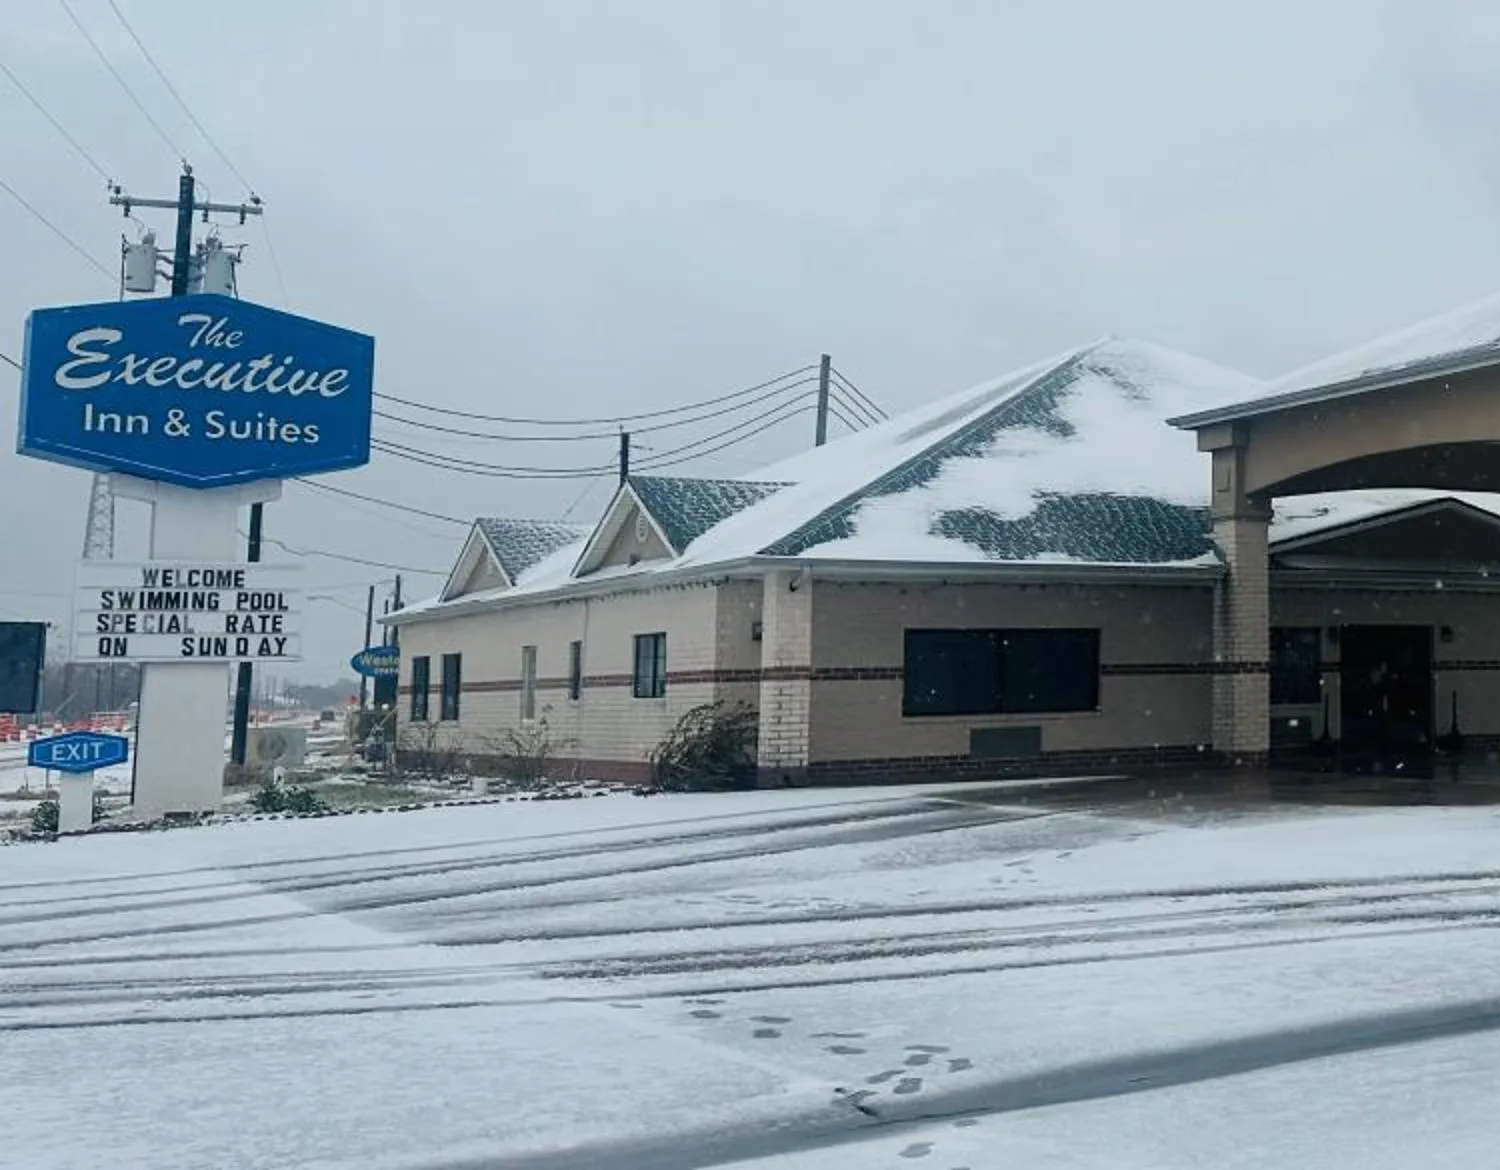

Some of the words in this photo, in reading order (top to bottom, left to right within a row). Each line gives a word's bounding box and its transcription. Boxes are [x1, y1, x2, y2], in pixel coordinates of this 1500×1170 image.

[178, 313, 243, 349] The
[55, 327, 349, 397] Executive
[84, 403, 149, 434] Inn
[163, 409, 190, 437] &
[205, 411, 320, 444] Suites
[143, 568, 245, 588] WELCOME
[101, 591, 219, 611] SWIMMING
[236, 592, 288, 611] POOL
[97, 614, 195, 634] SPECIAL
[225, 614, 284, 633] RATE
[99, 637, 128, 657] ON
[181, 637, 287, 657] SUNDAY
[51, 742, 104, 762] EXIT
